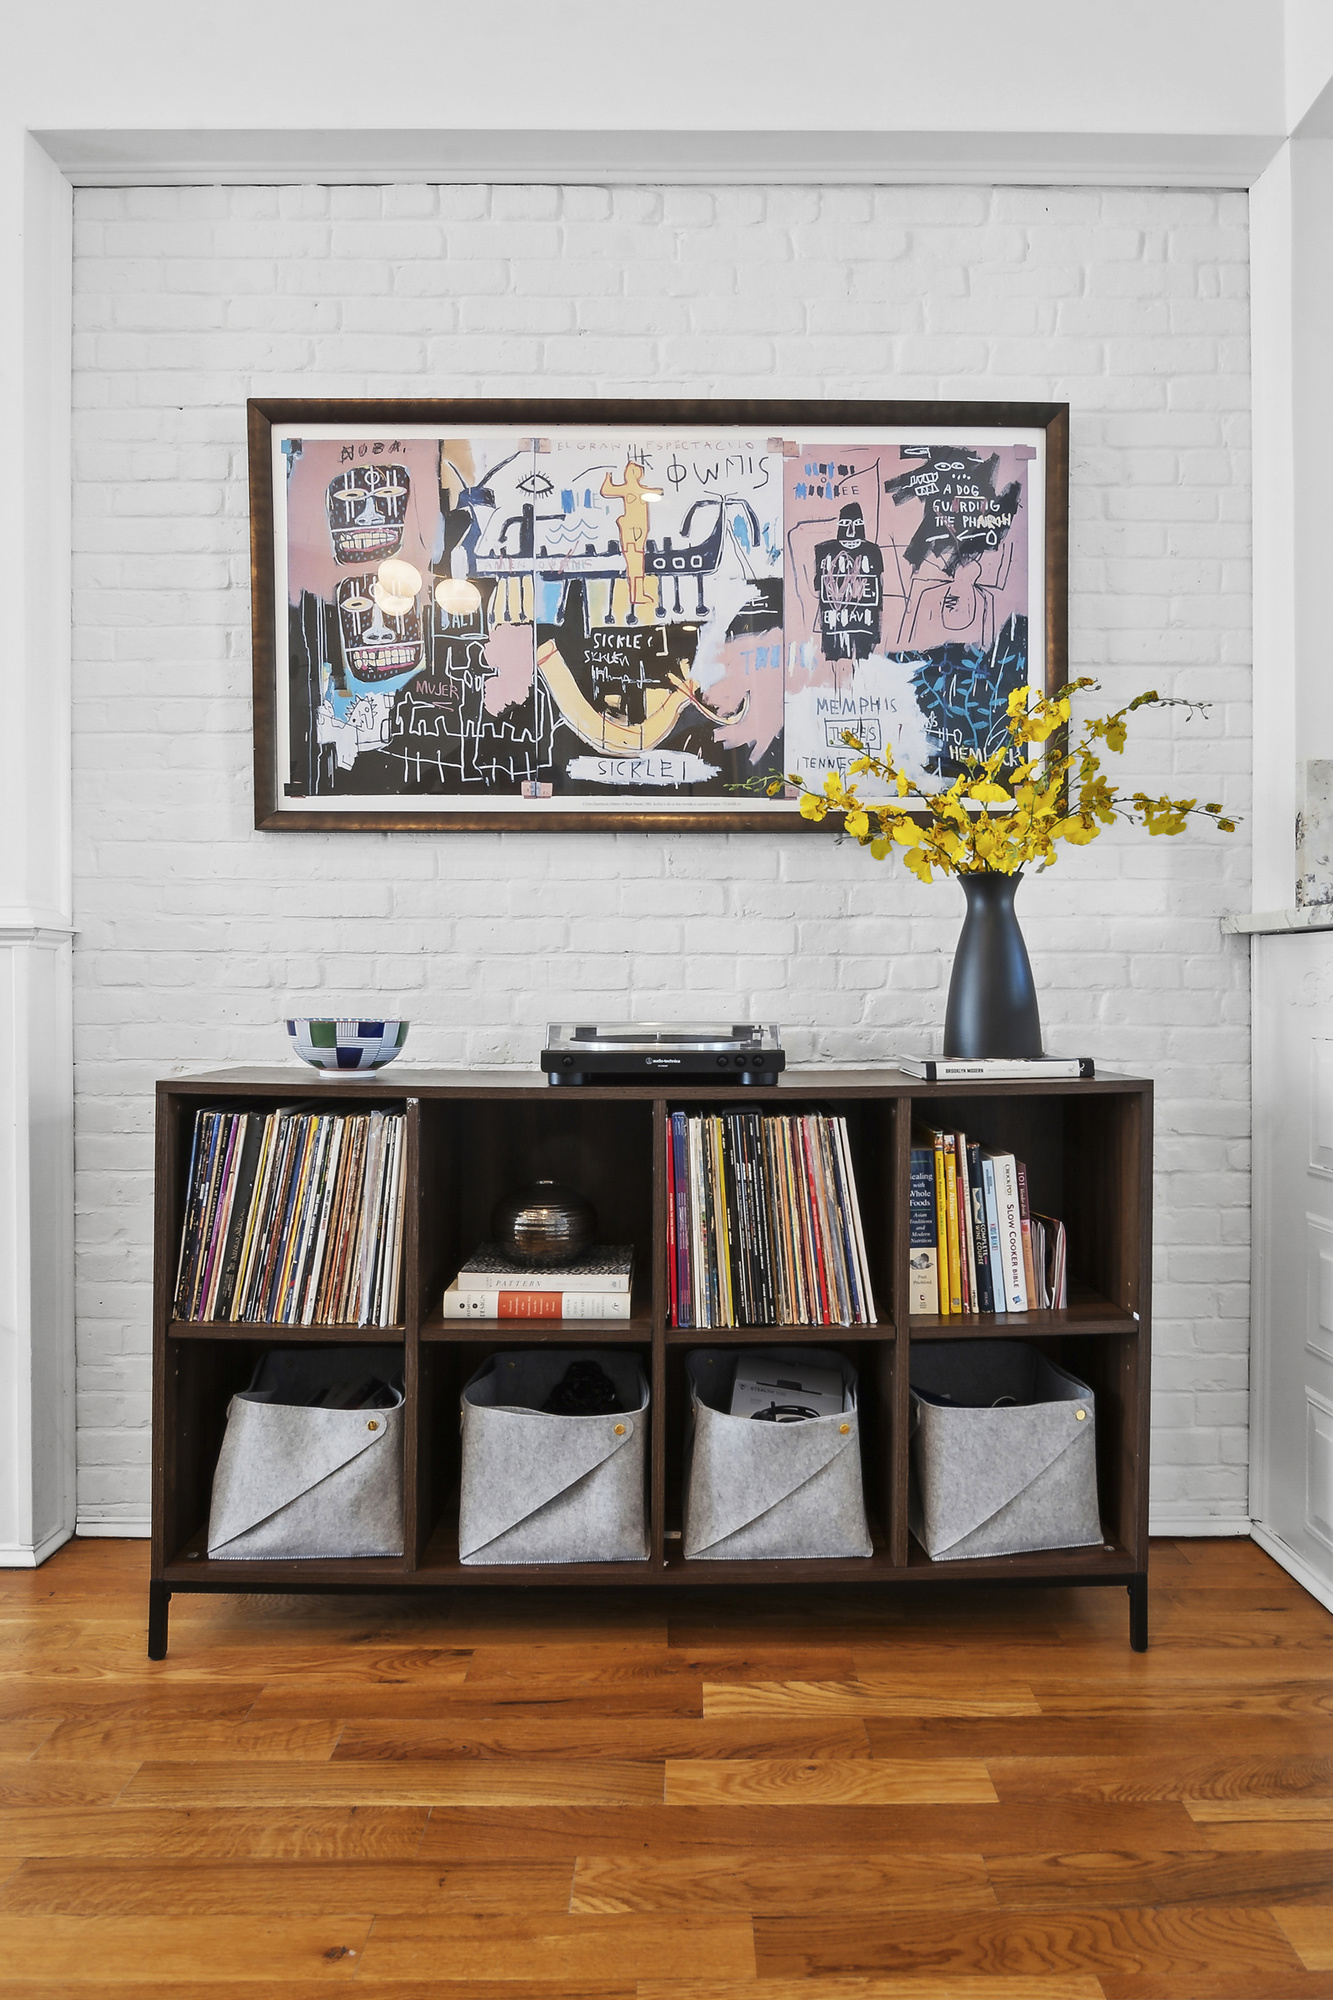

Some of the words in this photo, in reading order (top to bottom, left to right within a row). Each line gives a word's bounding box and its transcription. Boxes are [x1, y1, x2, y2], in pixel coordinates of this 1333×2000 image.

[943, 484, 952, 495] A
[956, 484, 979, 496] DOG
[593, 633, 643, 649] SICKLE
[416, 680, 460, 701] MUJER
[816, 696, 898, 716] MEMPHIS
[949, 1191, 957, 1220] African
[1006, 1203, 1015, 1229] SLOW
[976, 1242, 984, 1266] COURSE
[1008, 1231, 1018, 1267] COOKER
[1012, 1268, 1020, 1288] BIBLE
